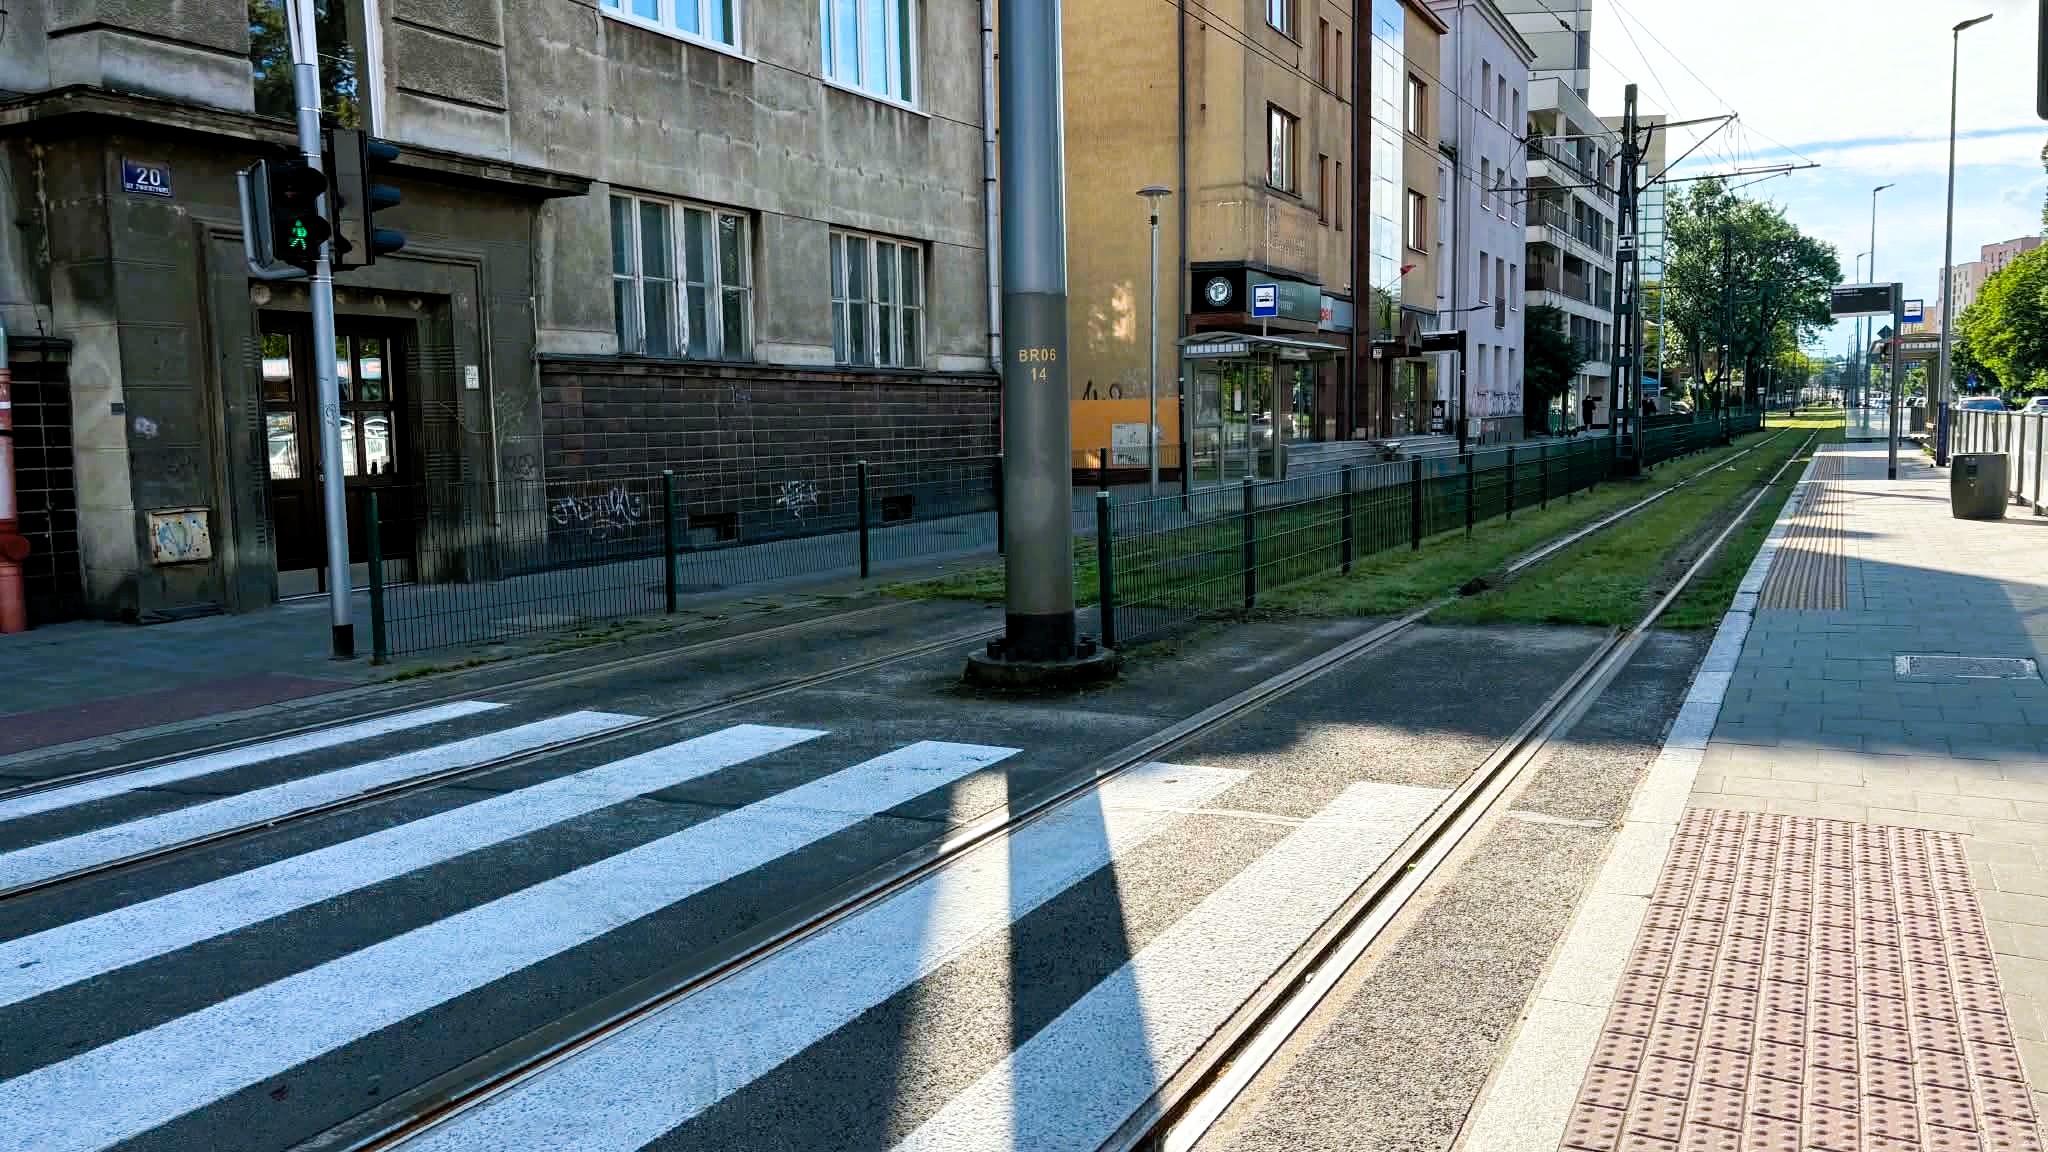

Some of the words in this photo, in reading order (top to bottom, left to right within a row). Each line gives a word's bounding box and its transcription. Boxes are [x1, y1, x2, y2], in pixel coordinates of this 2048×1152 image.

[136, 167, 161, 186] 20
[1018, 348, 1057, 362] BR06
[1031, 368, 1048, 381] 14
